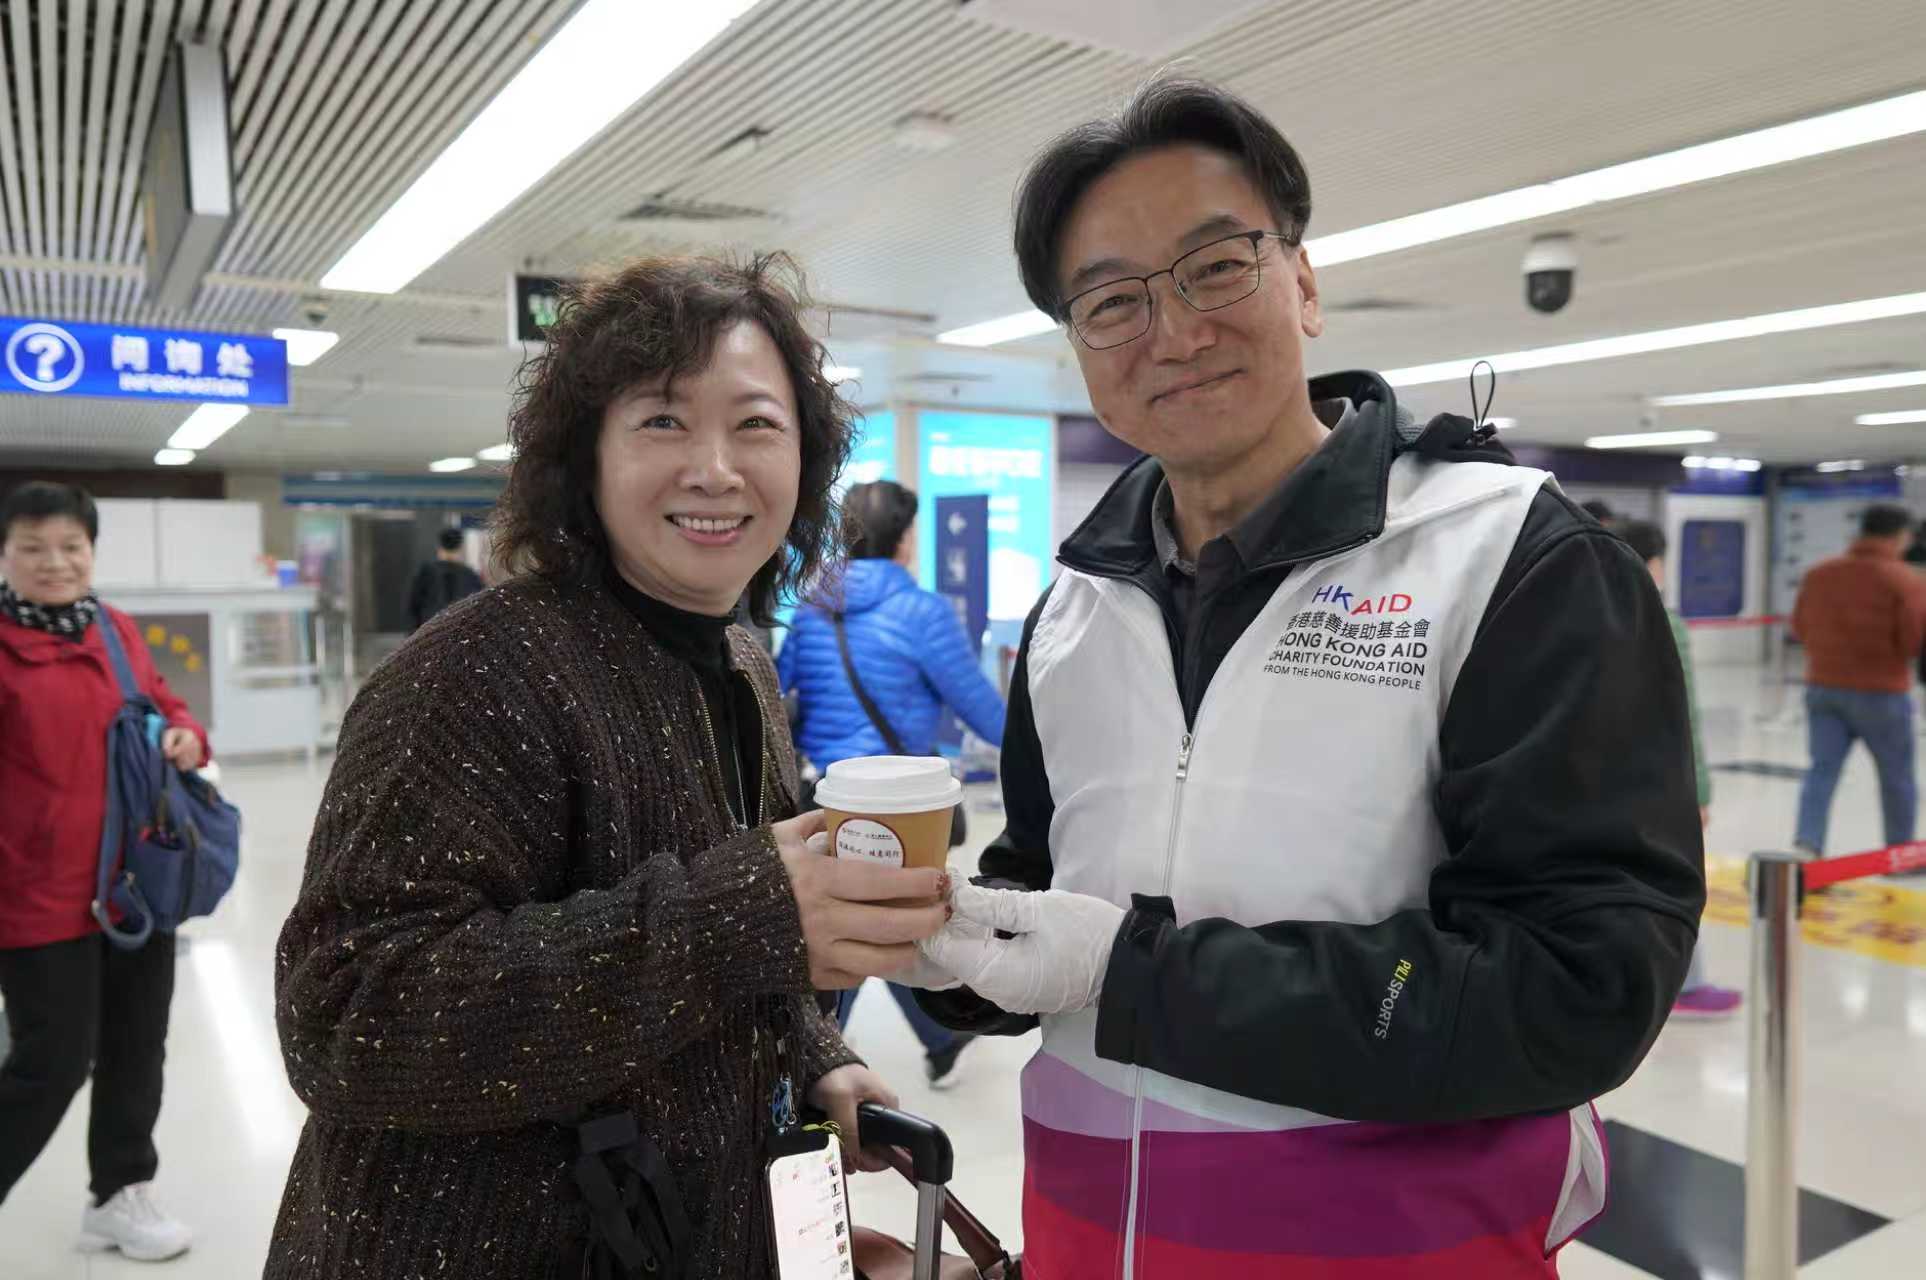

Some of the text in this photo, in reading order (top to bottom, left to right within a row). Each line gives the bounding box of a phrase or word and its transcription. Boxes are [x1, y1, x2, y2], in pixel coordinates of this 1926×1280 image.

[1351, 594, 1412, 616] AID
[1326, 637, 1386, 658] KONG
[1391, 642, 1428, 658] AID
[1322, 653, 1425, 676] FOUNDATION
[1264, 664, 1421, 690] FROM THE HONG KONG PEOPLE
[1374, 979, 1404, 1039] SPORTS
